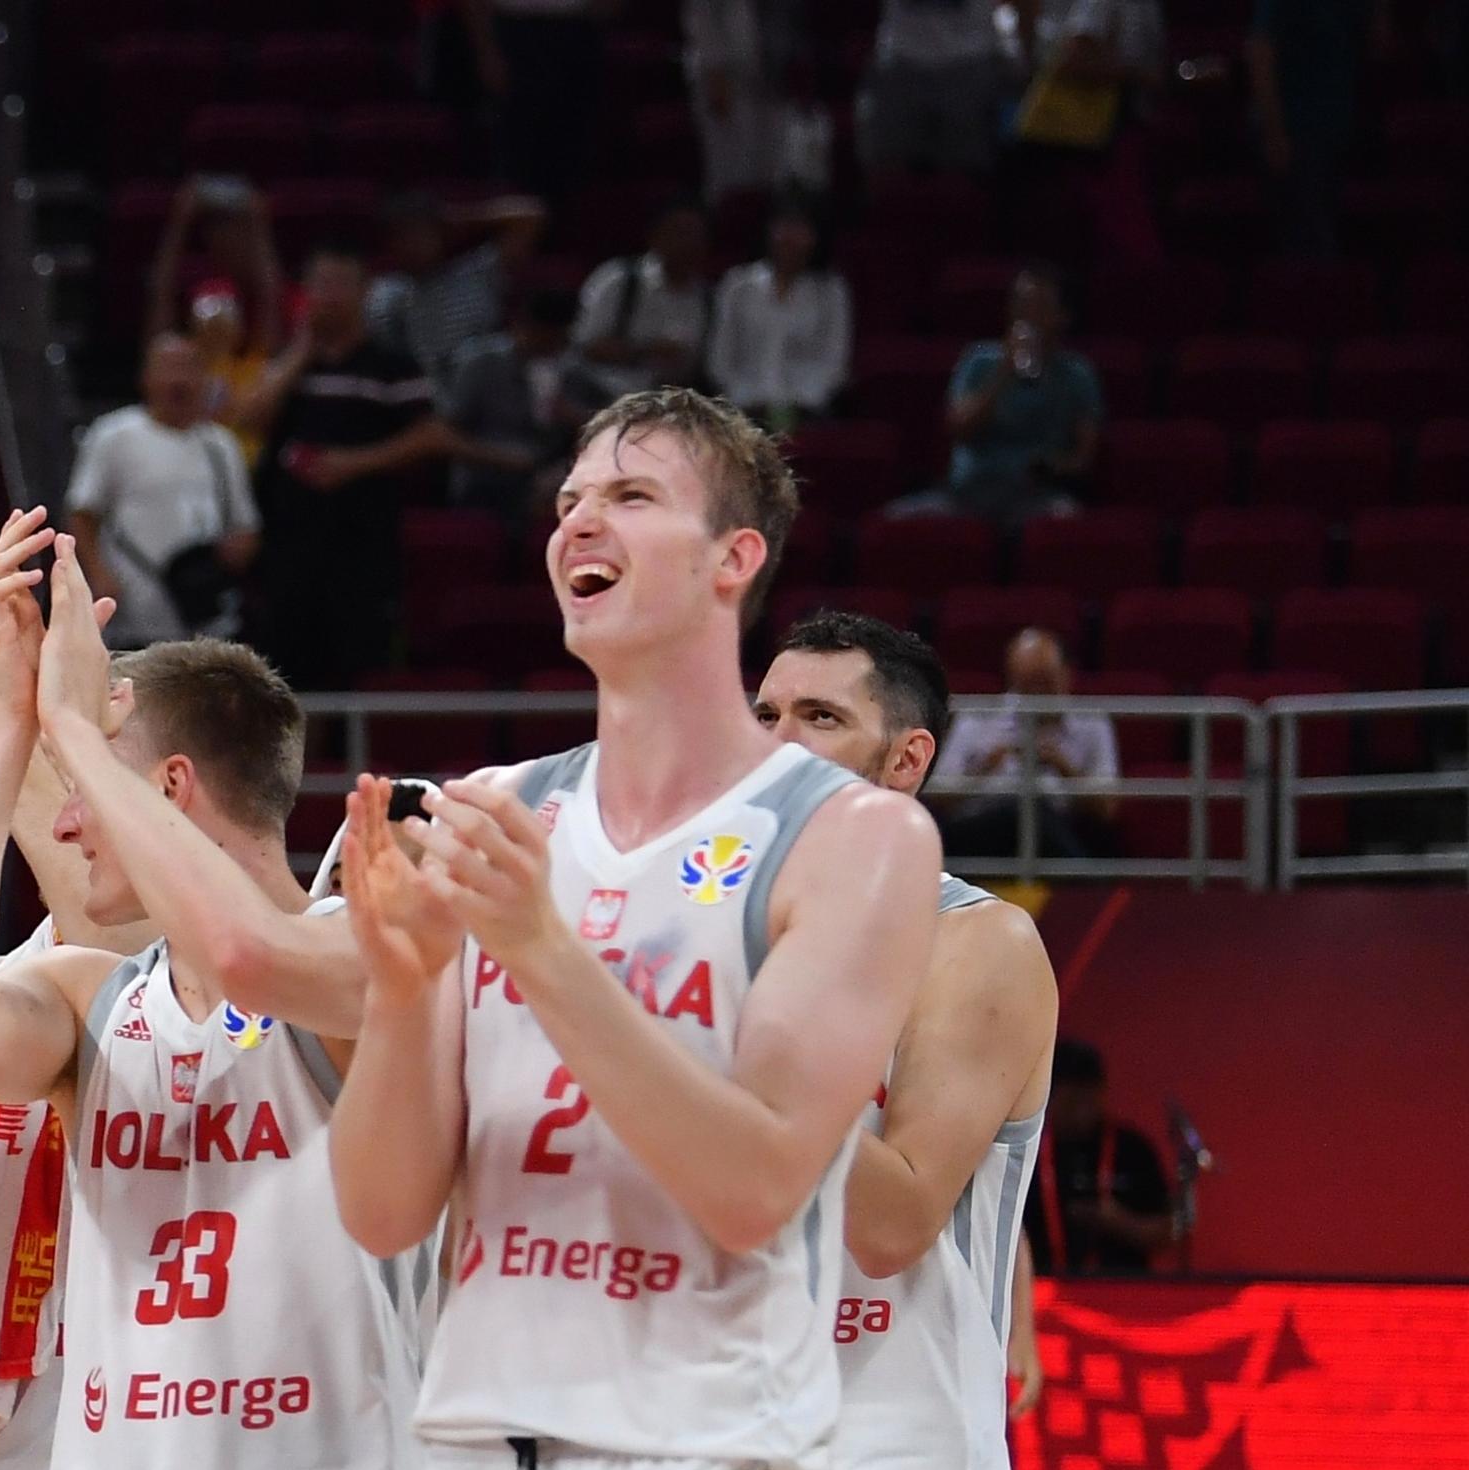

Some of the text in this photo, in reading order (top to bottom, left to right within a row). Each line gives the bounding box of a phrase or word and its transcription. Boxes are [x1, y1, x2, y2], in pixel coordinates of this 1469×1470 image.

[134, 1209, 237, 1326] 33
[499, 1225, 683, 1301] Energa
[124, 1373, 311, 1430] Energa
